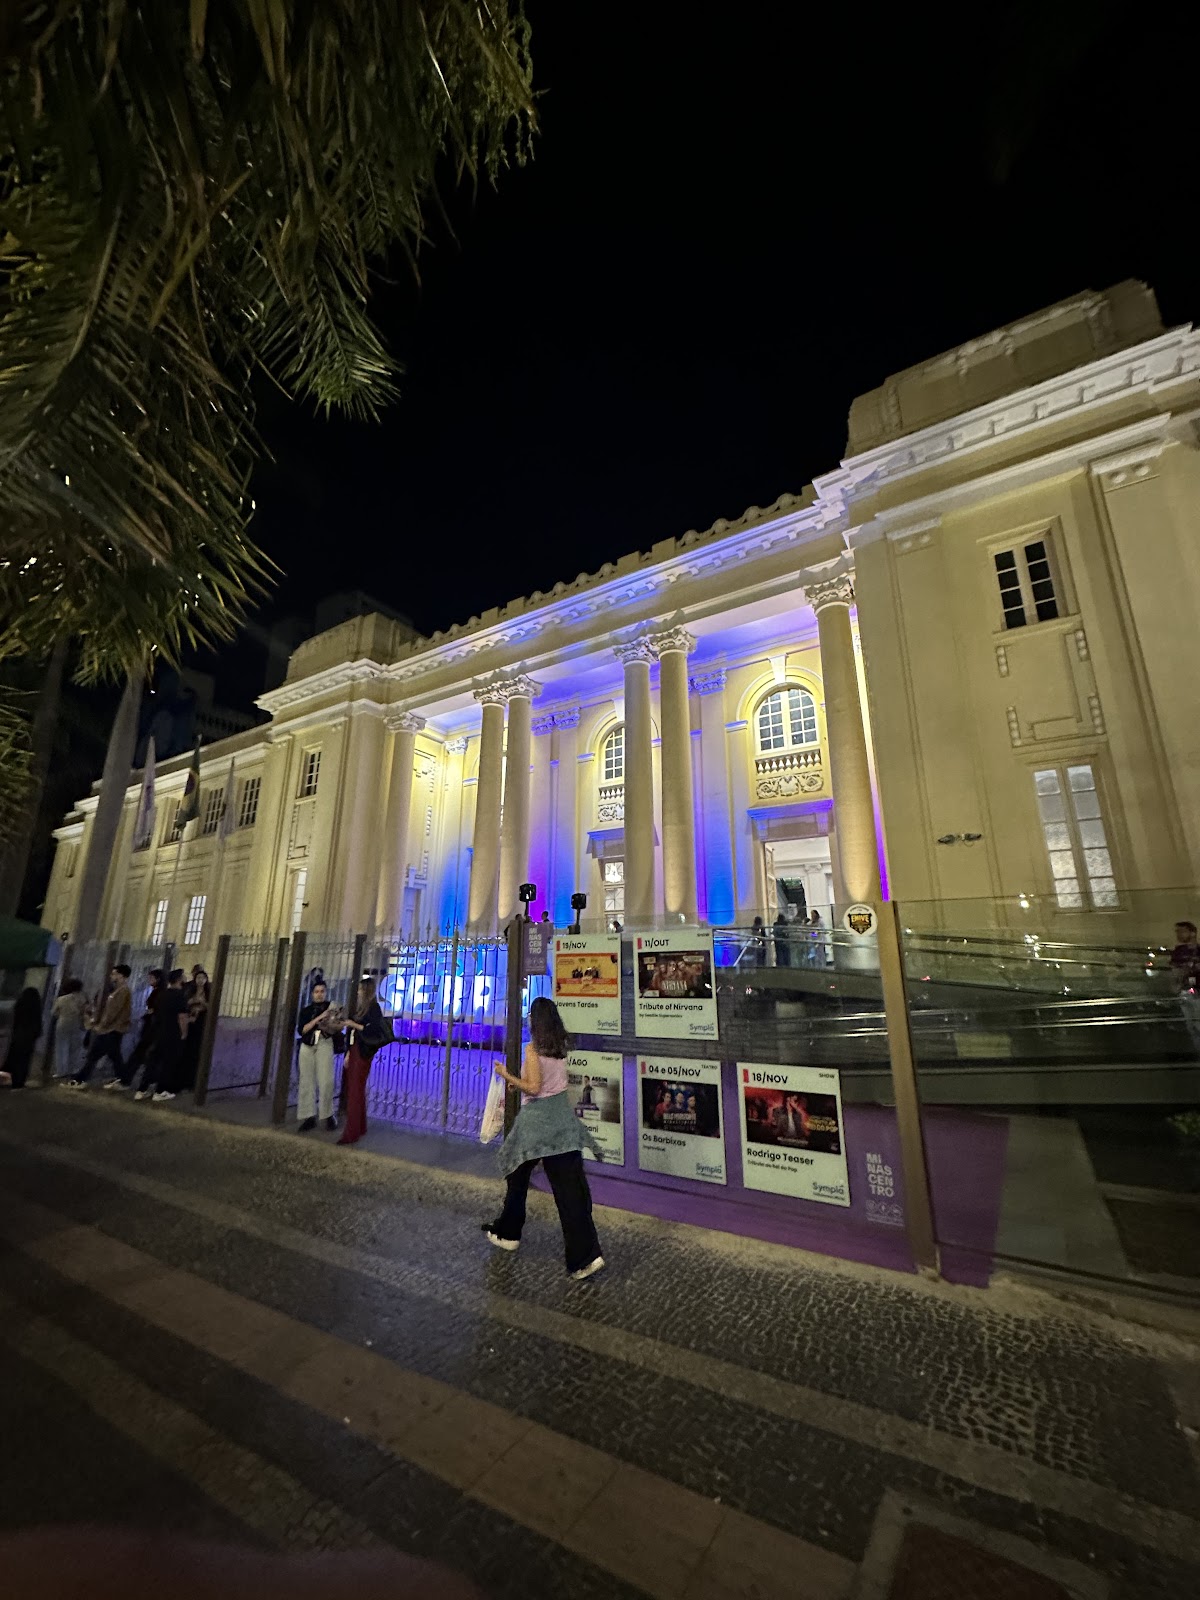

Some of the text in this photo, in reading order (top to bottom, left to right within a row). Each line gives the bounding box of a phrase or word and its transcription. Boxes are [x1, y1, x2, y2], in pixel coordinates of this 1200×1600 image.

[639, 1003, 664, 1011] Tribute
[673, 1003, 703, 1011] Nirvana
[649, 1065, 659, 1073] 04
[667, 1066, 701, 1077] 05/NOV
[752, 1072, 788, 1084] 18/NOV
[642, 1132, 687, 1147] Os Barbixas
[746, 1147, 815, 1166] Rodrigo Teaser
[867, 1163, 892, 1176] NAS
[868, 1174, 894, 1187] CEN
[869, 1184, 895, 1198] TRO
